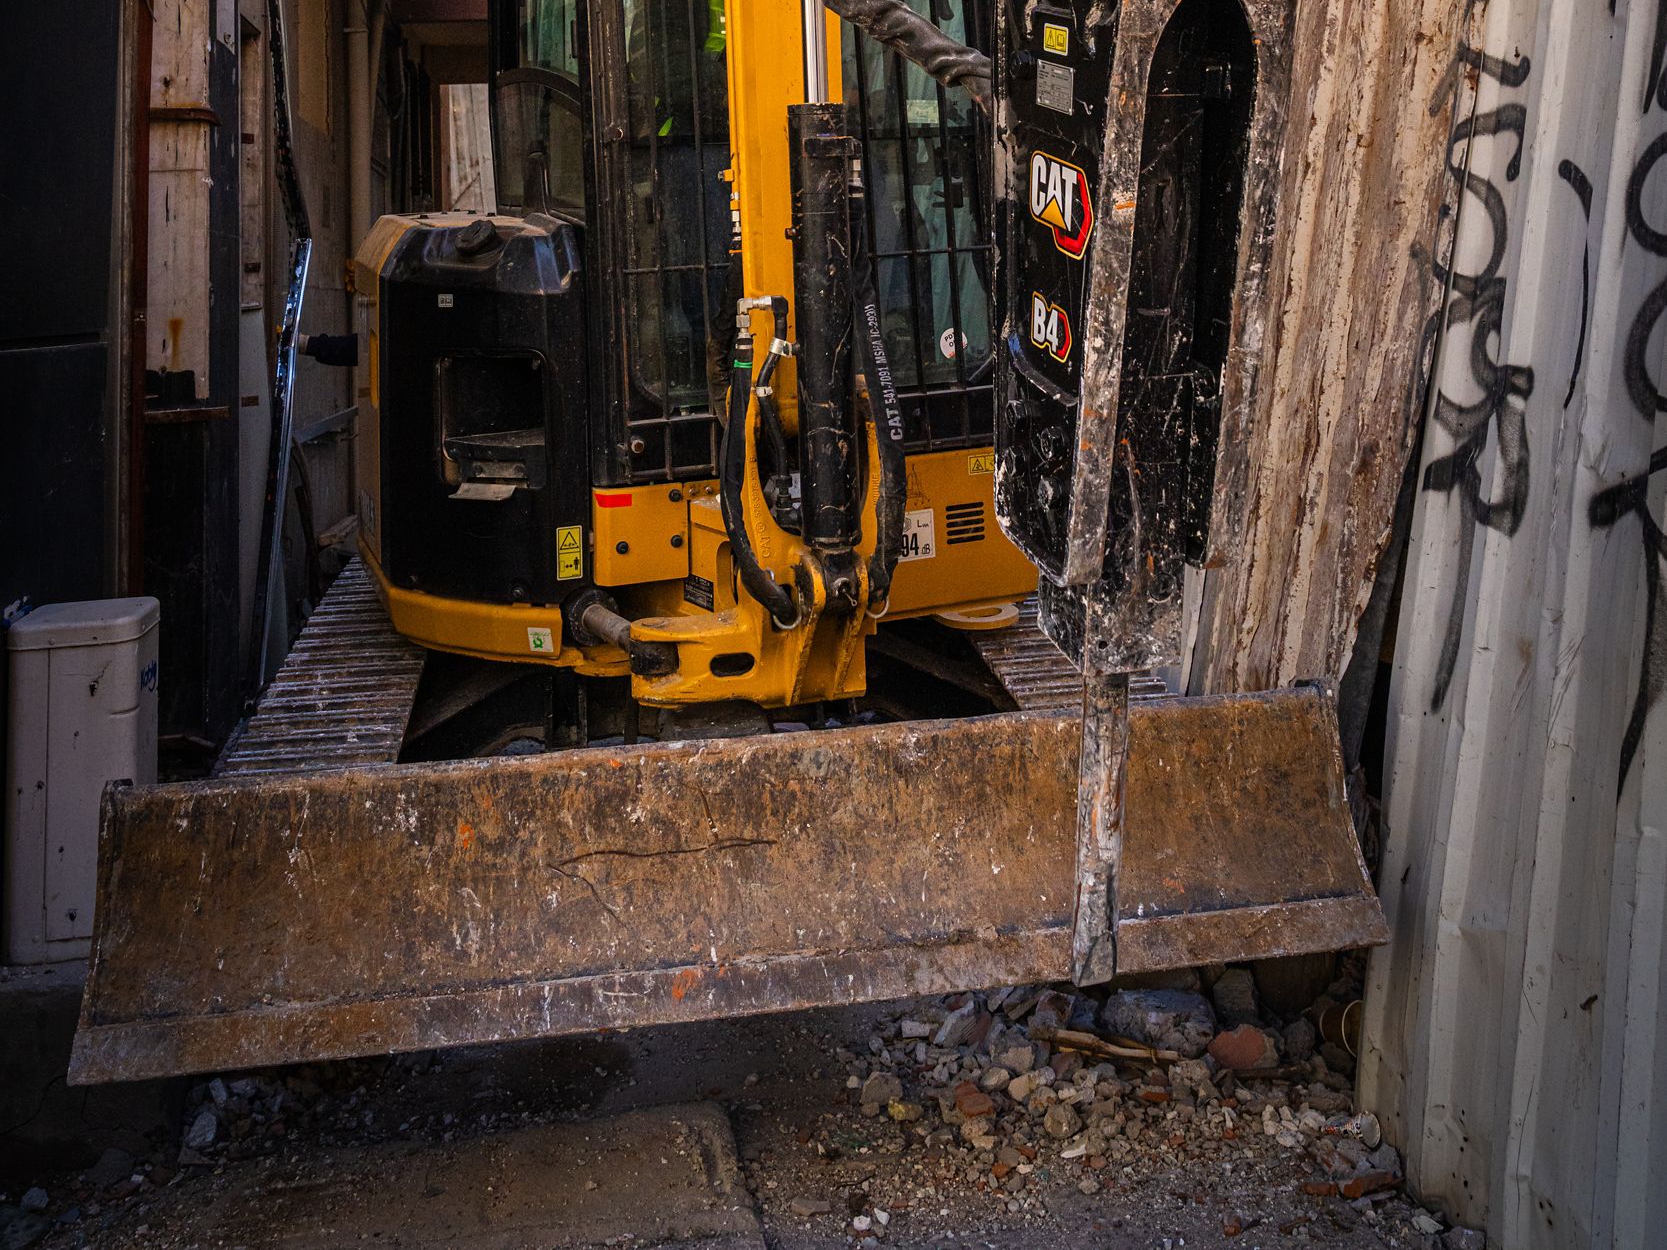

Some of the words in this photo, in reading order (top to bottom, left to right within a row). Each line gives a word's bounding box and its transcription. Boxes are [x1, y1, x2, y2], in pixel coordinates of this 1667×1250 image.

[1031, 153, 1078, 232] CAT
[1034, 297, 1059, 354] B4
[871, 339, 888, 365] MSHA
[877, 366, 897, 405] 541-7091
[885, 407, 904, 440] CAT
[901, 533, 920, 558] 94
[921, 543, 931, 555] dB
